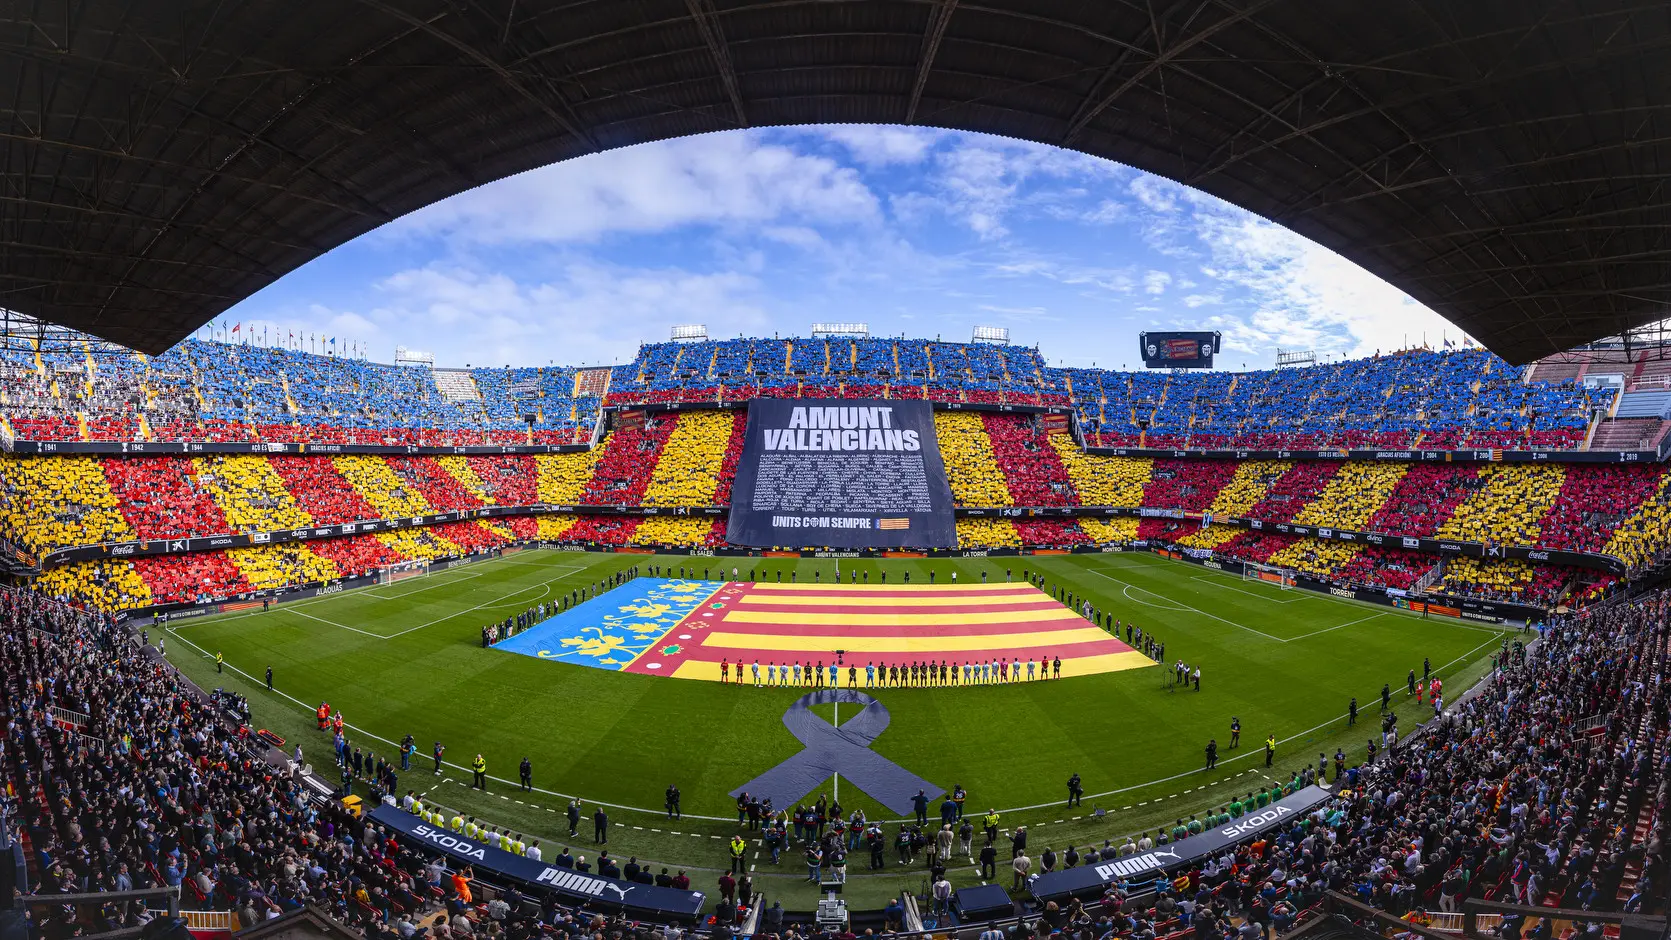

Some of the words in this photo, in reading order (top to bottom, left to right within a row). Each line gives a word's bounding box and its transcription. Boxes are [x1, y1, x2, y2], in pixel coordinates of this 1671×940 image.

[789, 407, 892, 429] AMUNT
[764, 429, 920, 451] VALENCIANS
[772, 516, 801, 527] UNITS
[832, 518, 871, 529] SEMPRE
[1330, 587, 1356, 599] TORRENT
[1095, 853, 1162, 880] PUMA
[536, 867, 607, 896] PUMA
